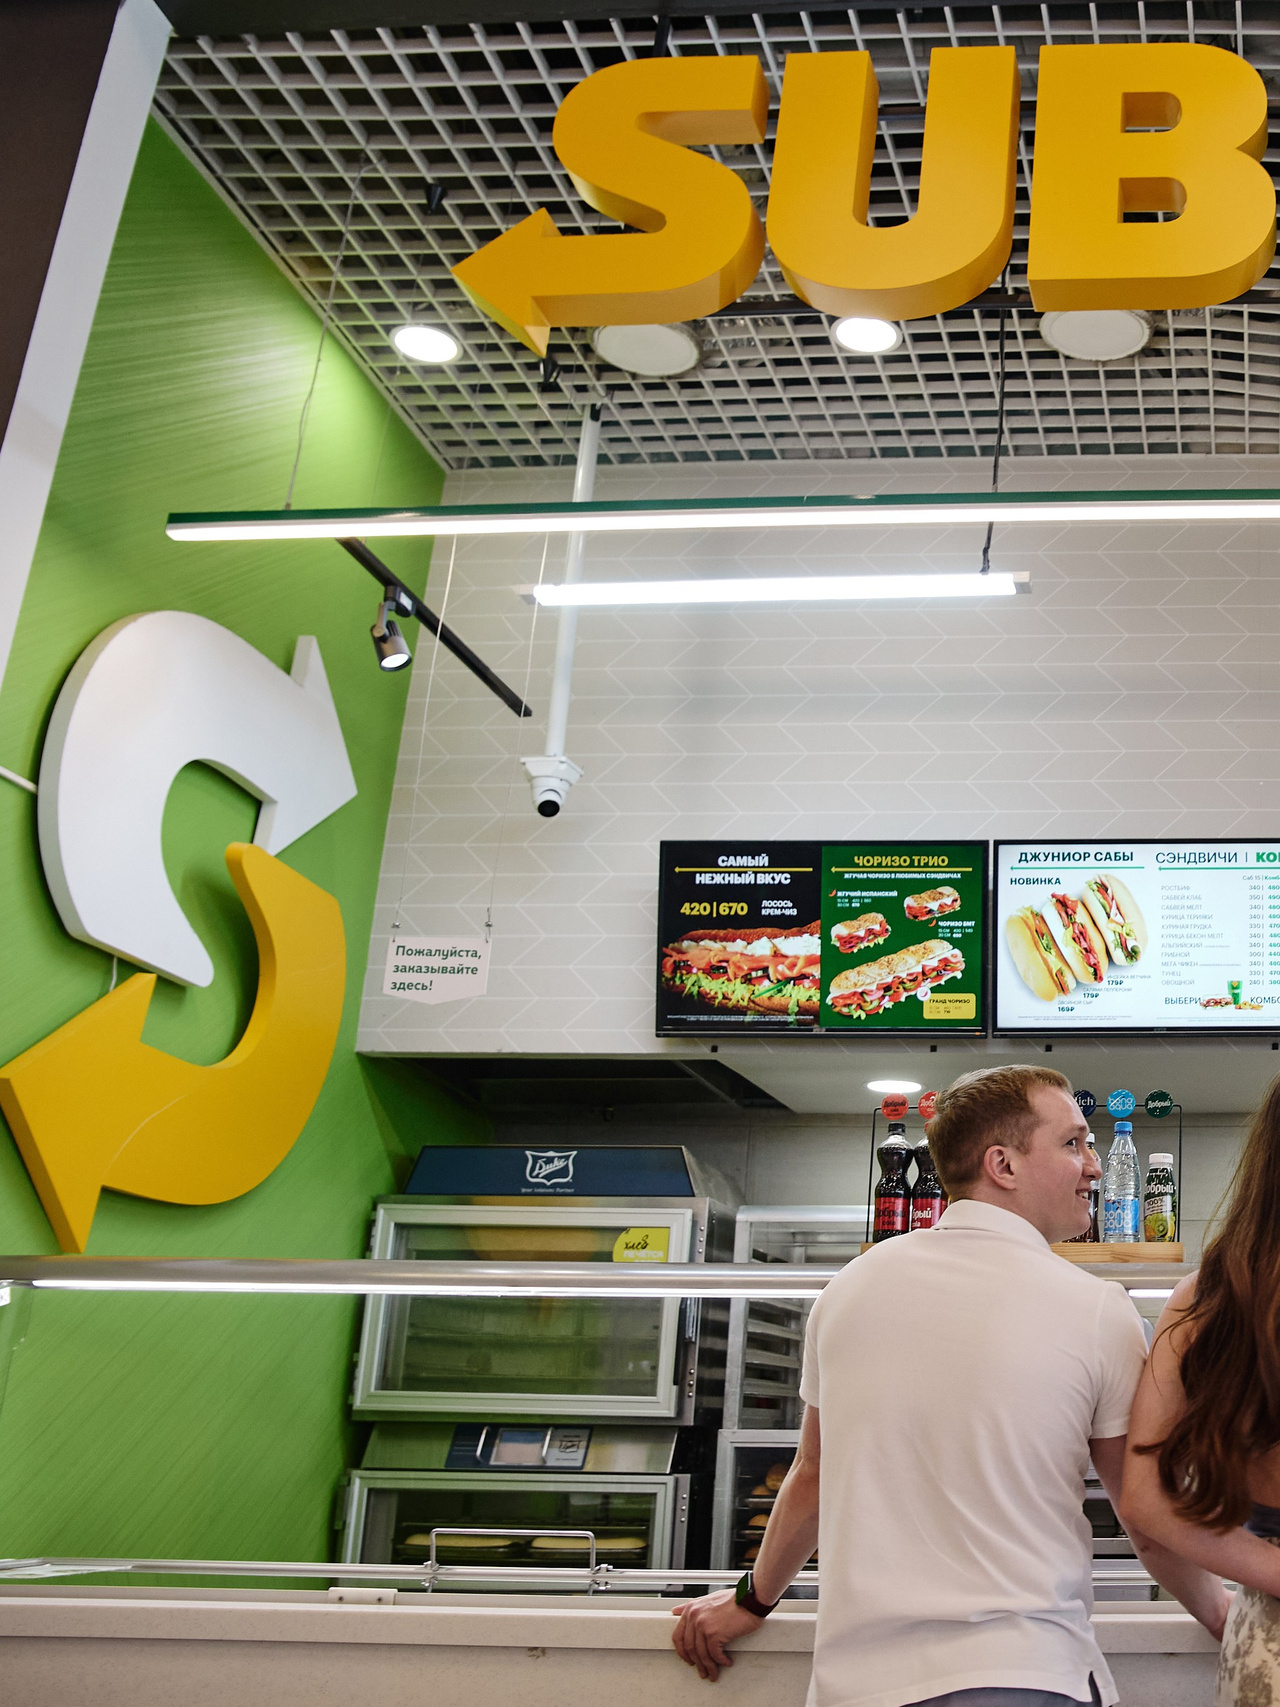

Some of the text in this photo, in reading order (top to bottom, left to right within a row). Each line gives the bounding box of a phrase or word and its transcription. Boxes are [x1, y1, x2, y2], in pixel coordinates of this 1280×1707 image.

[718, 853, 770, 867] САМЫЙ
[854, 855, 949, 867] ЧОРИЗО ТРИО
[1018, 851, 1134, 864] ДЖУНИОР САБЫ
[1155, 852, 1238, 865] СЭНДВИЧИ
[695, 871, 791, 884] НЕЖНЫЙ ВКУС
[1010, 877, 1061, 885] НОВИНКА
[680, 902, 748, 916] 420 670
[395, 945, 482, 960] Пожалуйста,
[392, 964, 478, 975] заказывайте
[391, 980, 433, 991] здесь!
[1164, 997, 1201, 1005] ВЫБЕРИ
[884, 1100, 906, 1108] Добрый
[1108, 1096, 1133, 1104] bona
[1148, 1098, 1170, 1109] Добрый
[532, 1157, 568, 1178] Duke
[624, 1234, 649, 1250] хлеб
